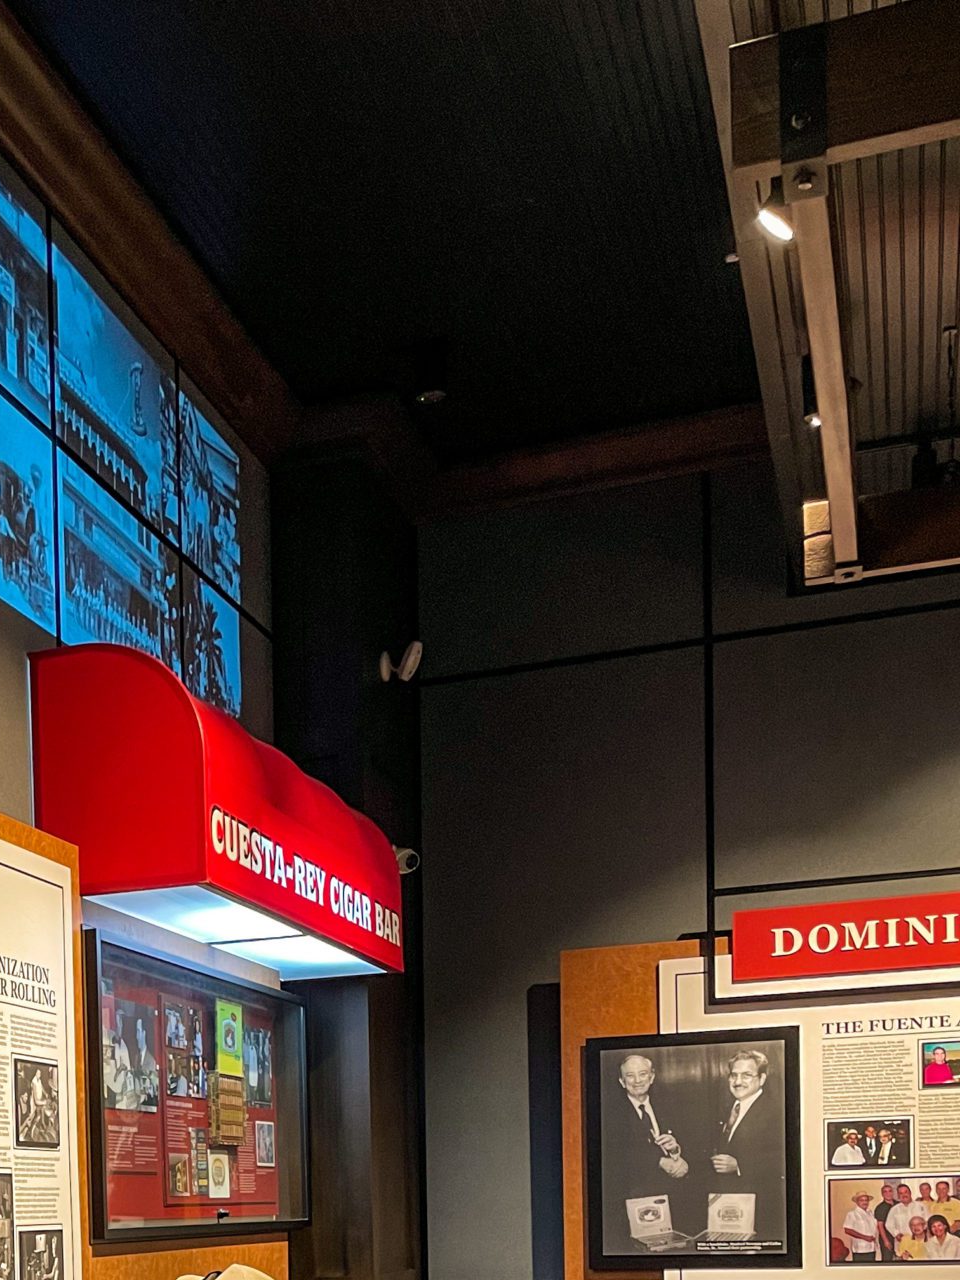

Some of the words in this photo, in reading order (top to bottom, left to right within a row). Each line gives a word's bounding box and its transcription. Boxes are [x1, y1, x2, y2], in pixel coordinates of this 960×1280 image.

[211, 808, 326, 907] CUESTA-REY
[330, 876, 372, 932] CIGAR
[375, 902, 401, 947] BAR
[10, 981, 57, 1008] ROLLING
[822, 1020, 863, 1035] THE
[869, 1015, 951, 1032] FUENTE
